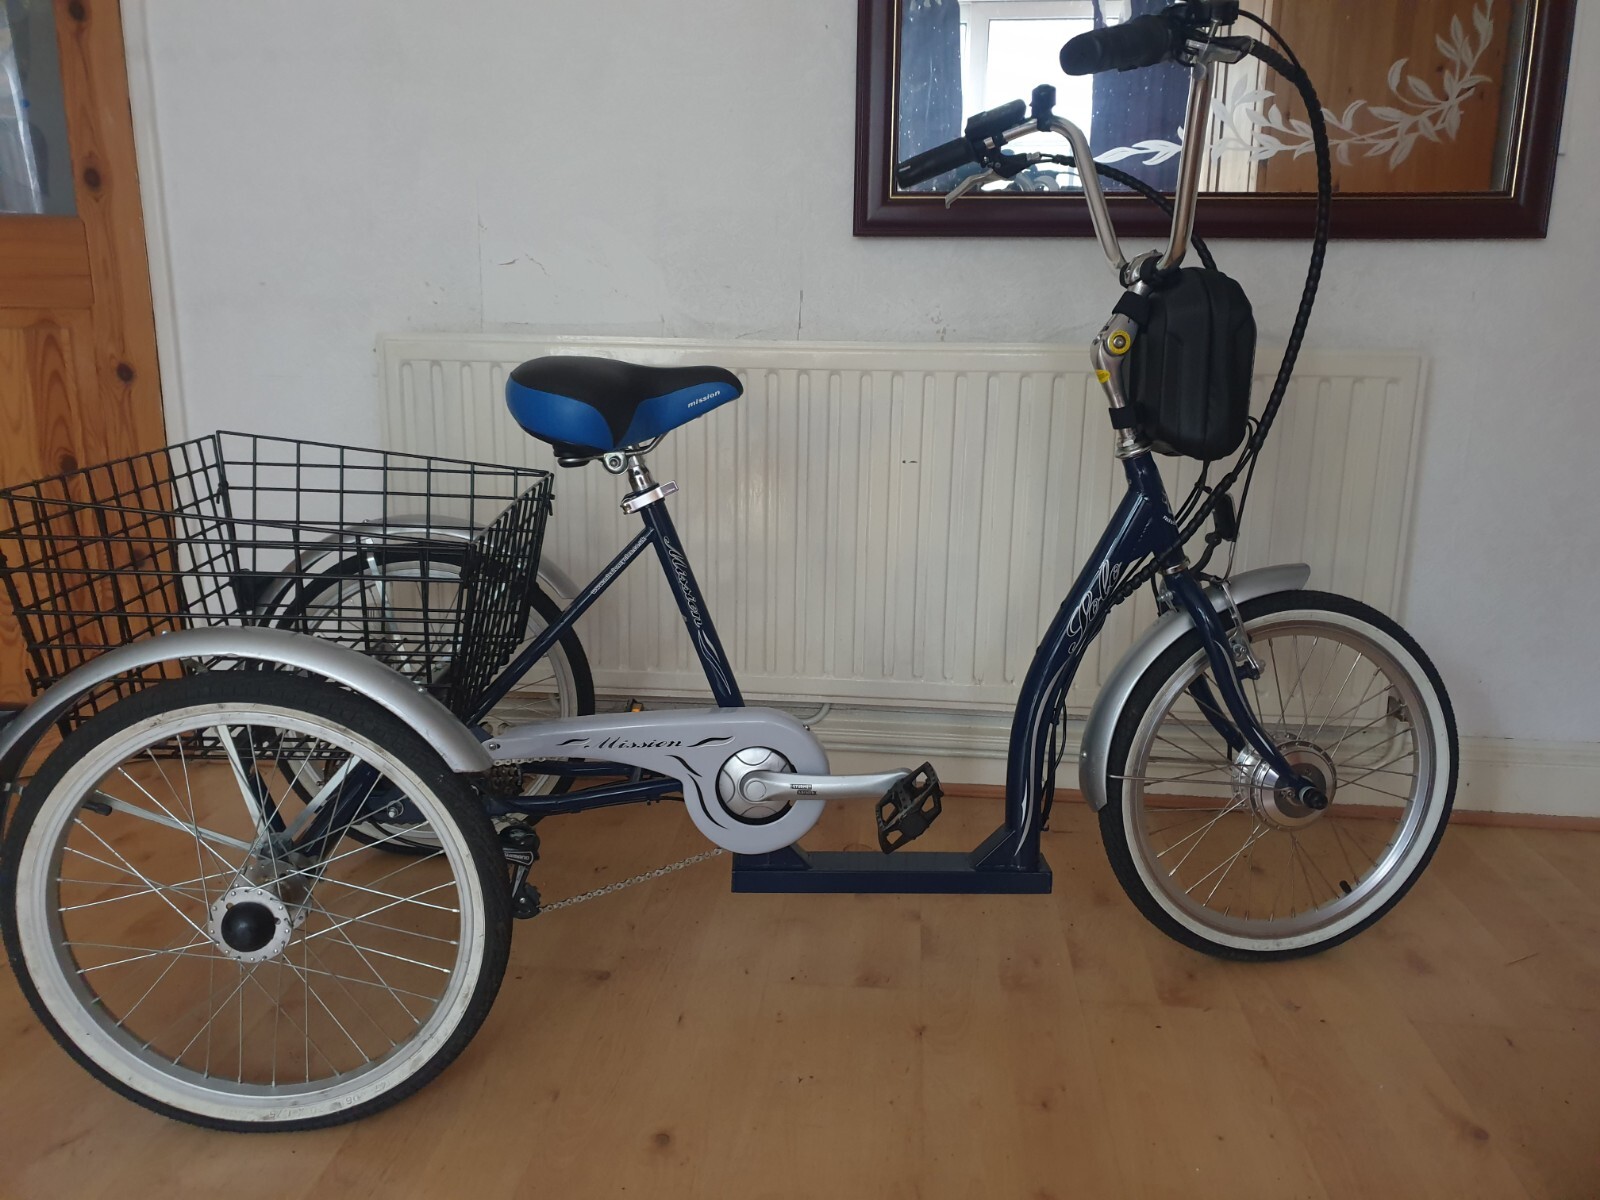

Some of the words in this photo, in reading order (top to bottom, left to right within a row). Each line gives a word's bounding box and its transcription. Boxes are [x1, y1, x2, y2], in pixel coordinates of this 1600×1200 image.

[687, 390, 721, 409] mission
[663, 536, 703, 629] Mission
[584, 736, 683, 749] Mission
